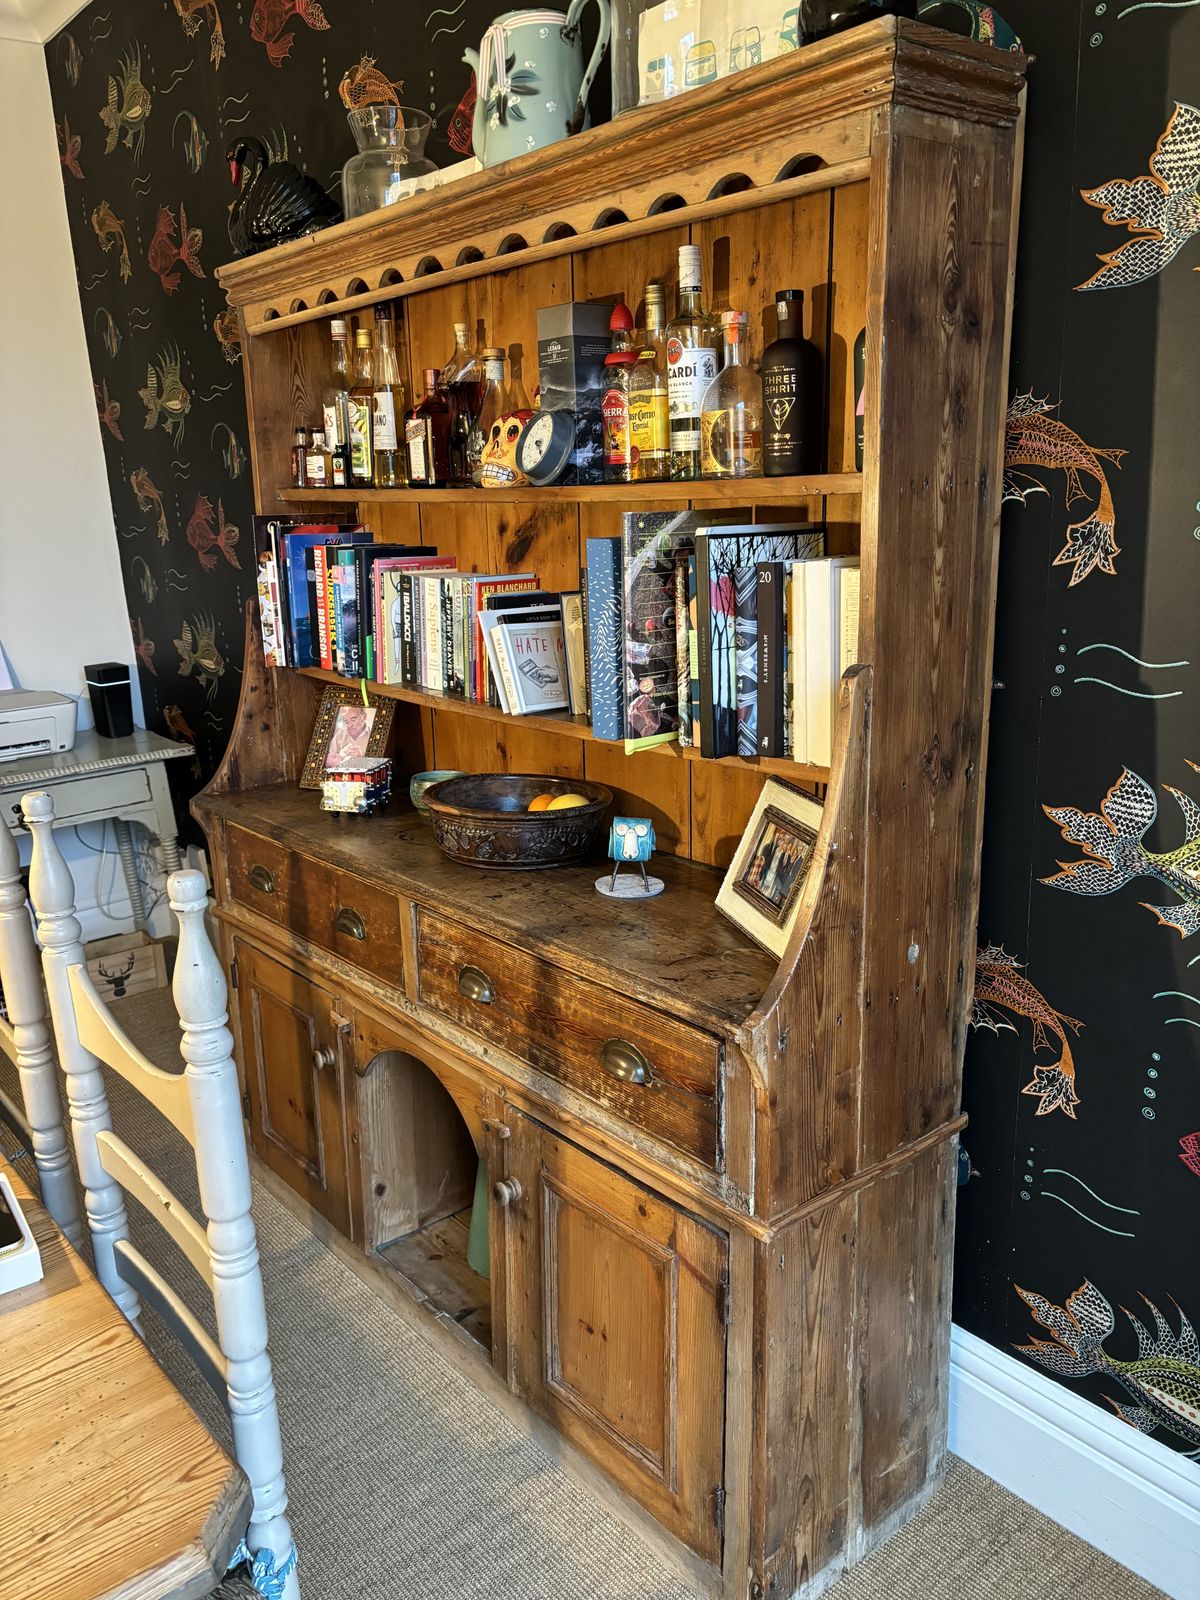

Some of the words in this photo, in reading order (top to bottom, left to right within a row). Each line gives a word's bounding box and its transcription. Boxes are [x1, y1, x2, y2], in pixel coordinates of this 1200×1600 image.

[765, 374, 797, 385] THREE
[765, 384, 797, 394] SPIRIT
[603, 407, 628, 417] SIERRA
[314, 549, 324, 597] RICHARD
[759, 571, 772, 583] 20
[481, 584, 495, 593] KEN
[496, 582, 537, 593] BLANCHARD
[317, 608, 328, 659] BRANSON
[428, 602, 439, 654] Sapiens
[516, 637, 549, 654] HATE
